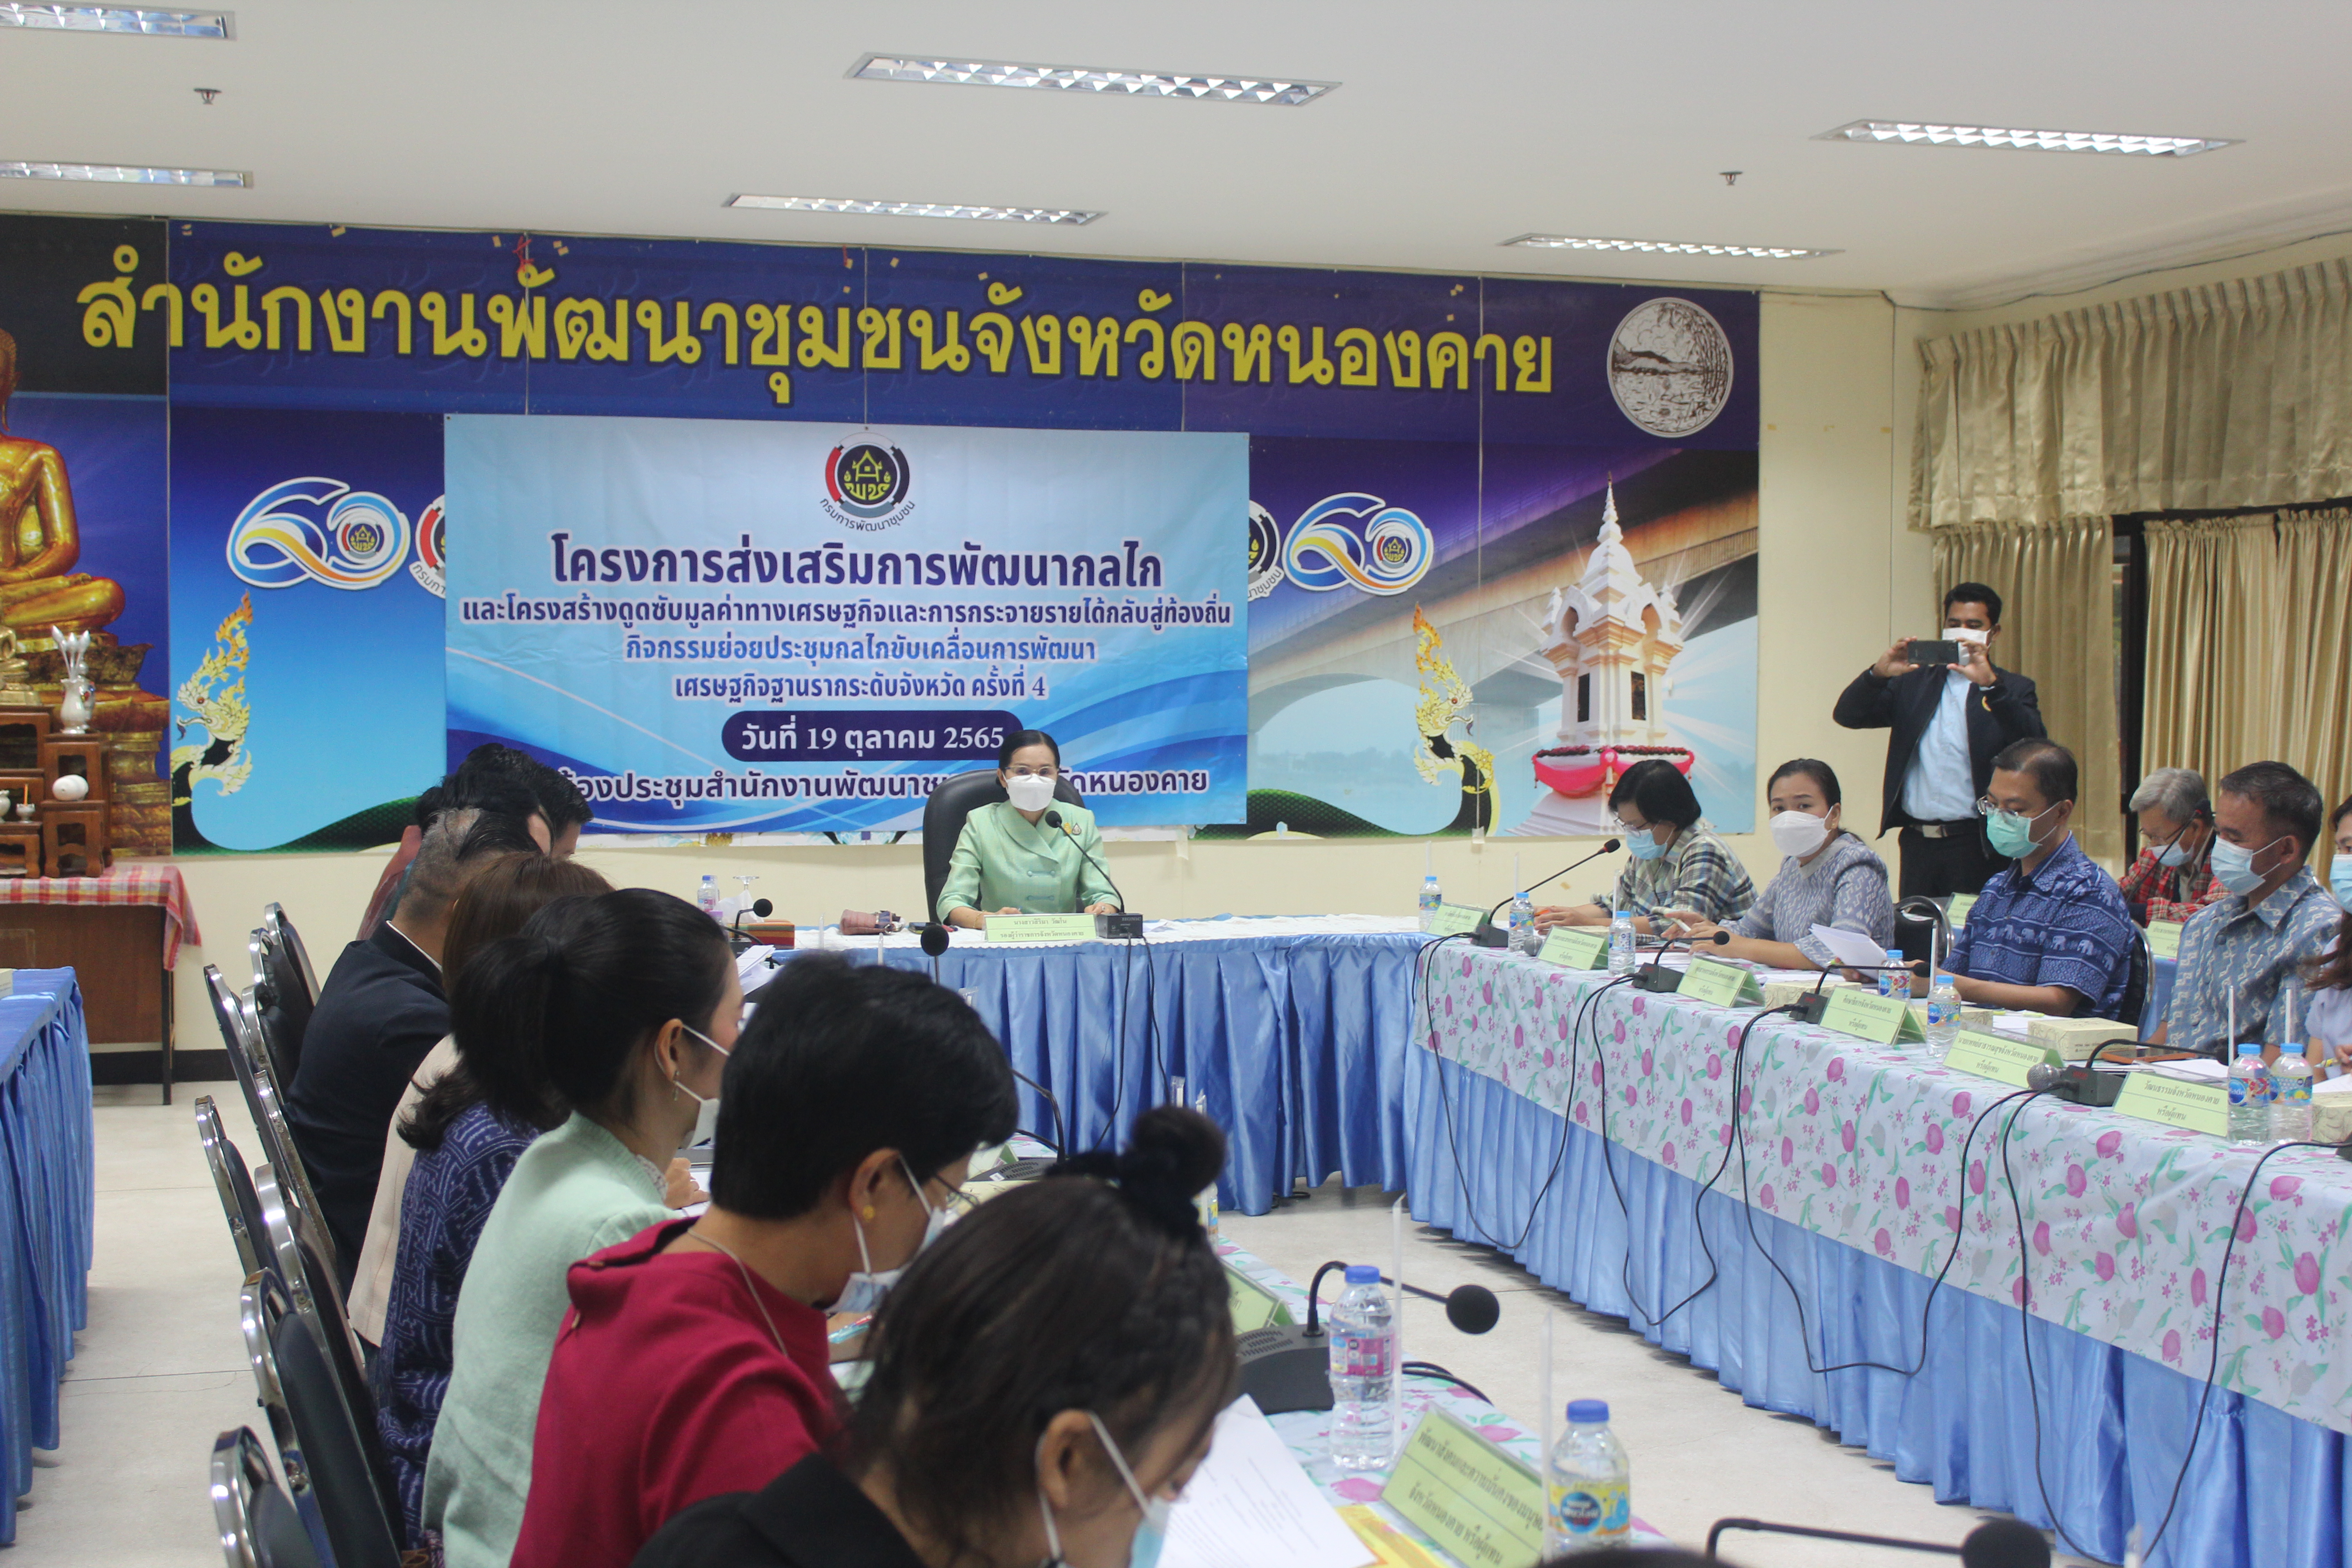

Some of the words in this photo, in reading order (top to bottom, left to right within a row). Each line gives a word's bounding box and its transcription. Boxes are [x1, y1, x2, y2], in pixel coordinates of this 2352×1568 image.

[77, 245, 1552, 404] สำนักงานพัฒนาชุมชนจังหวัดหนองคาย
[819, 498, 916, 531] กรมการพัฒนาชุมชน
[551, 533, 1161, 587] โครงการส่งเสริมการพัฒนากลไก
[463, 593, 1231, 630] และโครงสร้างดูดซับมูลค่าทางเศรษฐกิจและการกระจายรายได้กลับสู่ท้องถิ่น
[627, 628, 1095, 666] กิจกรรมย่อยประชุมกลไกขับเคลื่อนการพัฒนา
[676, 671, 965, 703] เศรษฐกิจฐานรากระดับจังหวัด
[972, 665, 1025, 697] ครั้งที่
[1032, 676, 1045, 696] 4
[742, 715, 796, 750] วันที่
[807, 727, 837, 749] 19
[845, 730, 935, 757] ตุลาคม
[944, 727, 1004, 749] 2565
[2144, 1079, 2220, 1105] วัฒนธรรมจังหวัดหนองคาย
[2156, 1105, 2187, 1121] หรือผู้แทน
